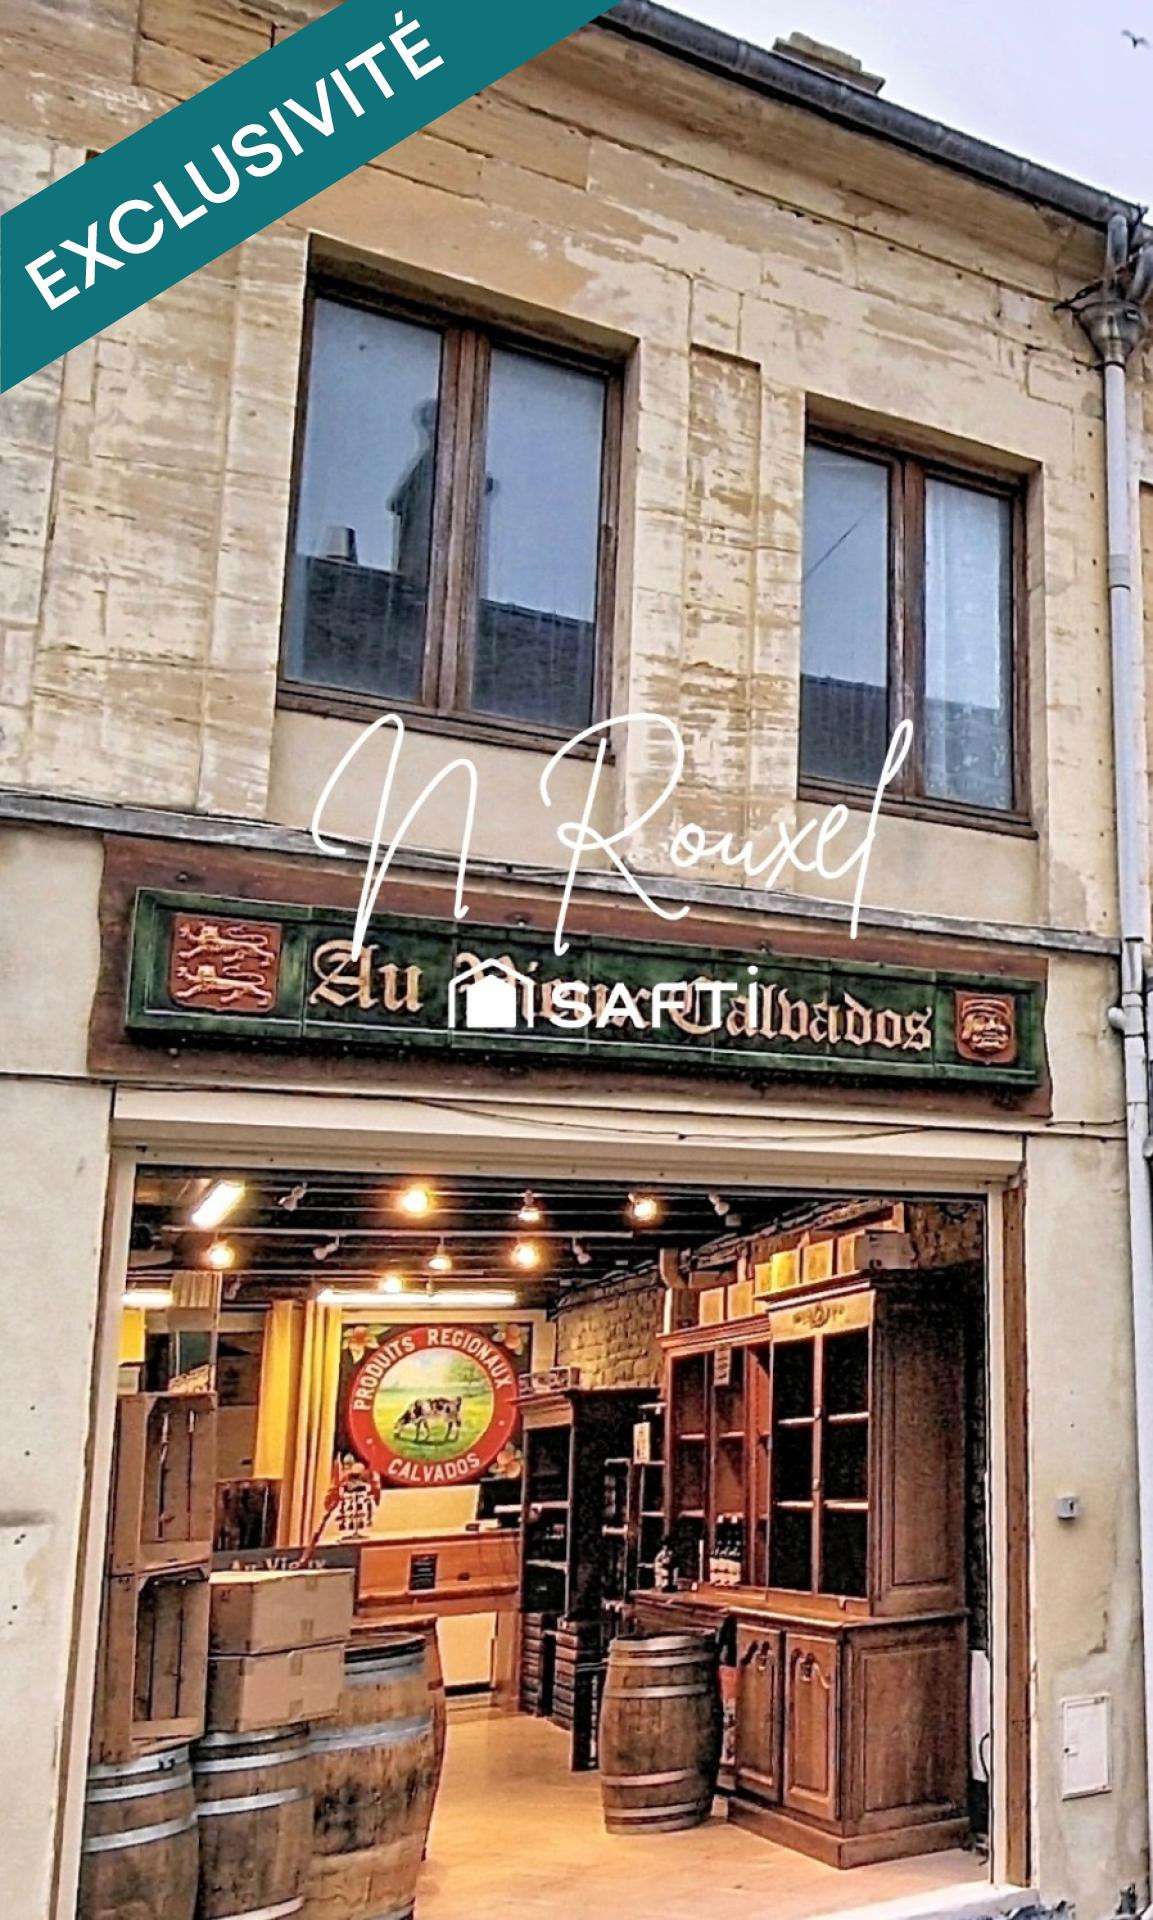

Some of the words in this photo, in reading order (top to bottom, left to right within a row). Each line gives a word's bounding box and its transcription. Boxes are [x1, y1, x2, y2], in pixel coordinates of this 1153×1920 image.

[309, 938, 425, 1013] Au
[668, 976, 933, 1051] Calvados
[353, 1336, 415, 1411] PRODUITS
[427, 1328, 512, 1388] REGIONAUX
[388, 1453, 481, 1483] CALVADOS
